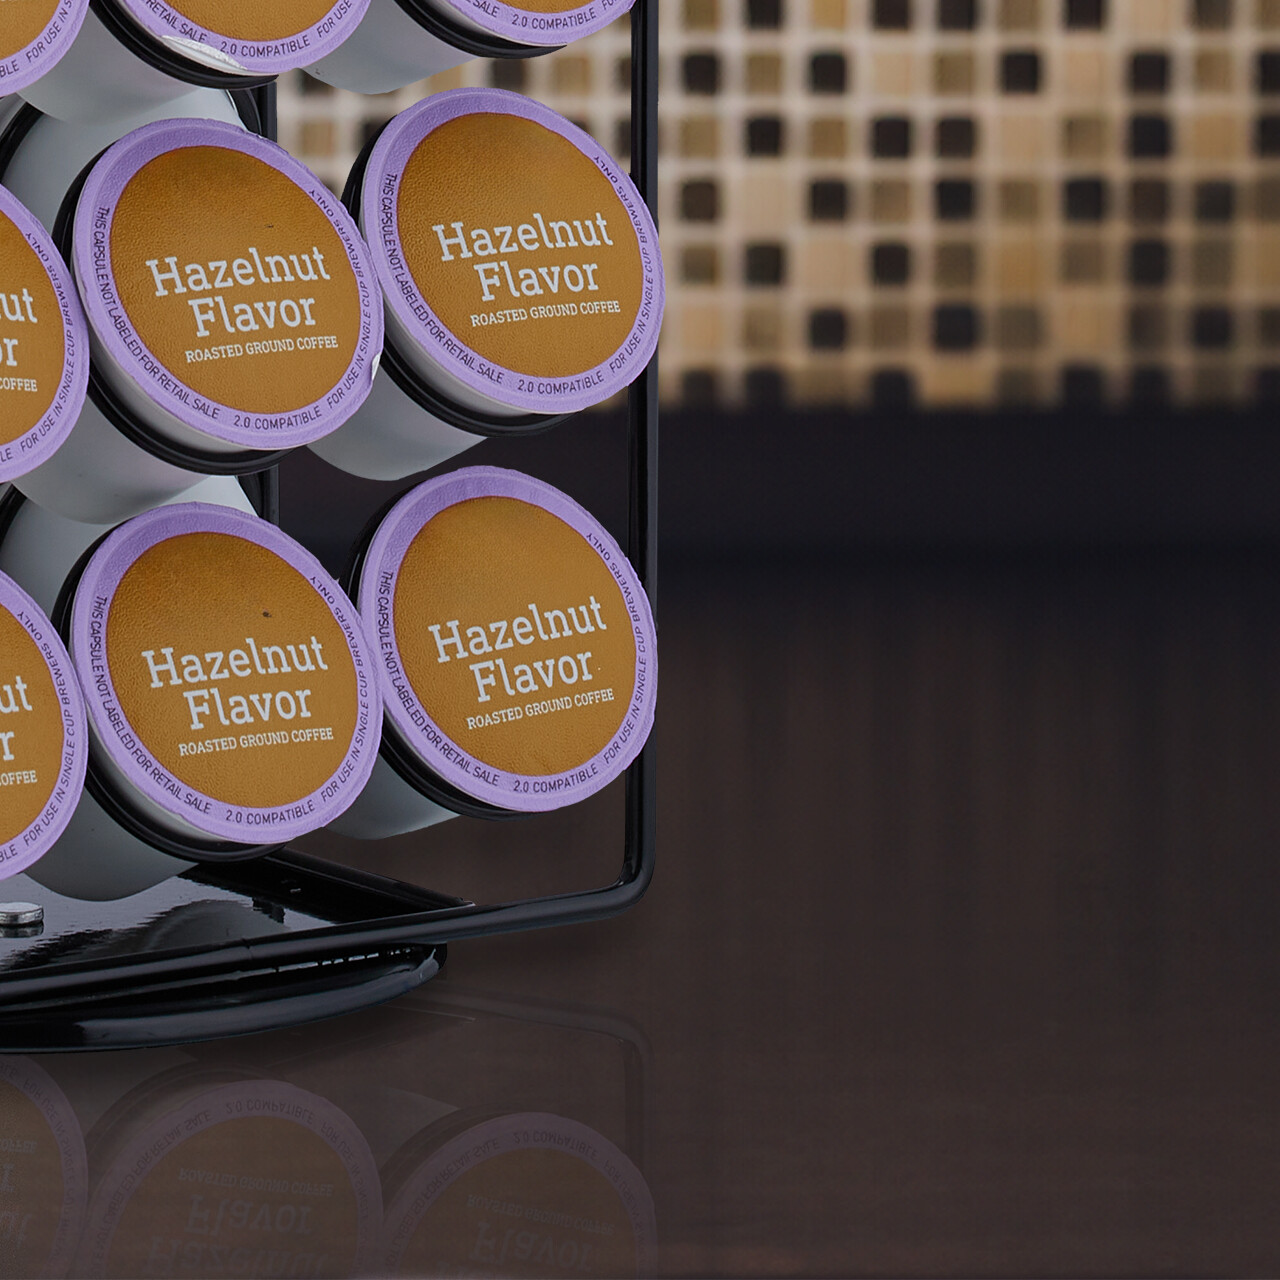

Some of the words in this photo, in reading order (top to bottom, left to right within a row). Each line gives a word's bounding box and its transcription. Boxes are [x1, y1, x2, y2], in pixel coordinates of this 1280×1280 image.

[512, 13, 529, 28] 2.0
[532, 6, 597, 29] COMPATIBLE
[220, 41, 238, 56] 2.0
[241, 35, 311, 58] COMPATIBLE
[432, 212, 614, 261] Hazelnut
[145, 246, 331, 296] Hazelnut
[473, 260, 599, 302] Flavor
[187, 295, 316, 337] Flavor
[469, 308, 528, 327] ROASTED
[529, 301, 578, 319] GROUND
[579, 300, 621, 314] COFFEE
[184, 343, 243, 363] ROASTED
[245, 337, 295, 355] GROUND
[296, 335, 339, 350] COFFEE
[518, 379, 535, 393] 2.0
[538, 369, 606, 394] COMPATIBLE
[235, 416, 252, 430] 2.0
[256, 406, 324, 431] COMPATIBLE
[310, 576, 336, 607] ONLY
[92, 596, 108, 619] THIS
[334, 607, 364, 669] BREWERS
[428, 598, 609, 662] Hazelnut
[90, 620, 103, 672] CAPSULE
[141, 636, 329, 688] Hazelnut
[95, 674, 111, 698] NOT
[360, 672, 368, 700] CUP
[469, 652, 593, 702] Flavor
[182, 687, 311, 730] Flavor
[466, 705, 523, 729] ROASTED
[524, 695, 572, 716] GROUND
[573, 689, 615, 707] COFFEE
[102, 699, 137, 751] LABELED
[356, 703, 370, 747] SINGLE
[178, 736, 237, 756] ROASTED
[239, 730, 289, 748] GROUND
[291, 728, 334, 743] COFFEE
[350, 747, 362, 763] IN
[131, 748, 153, 773] FOR
[337, 761, 354, 785] USE
[149, 767, 183, 801] RETAIL
[320, 780, 339, 802] FOR
[513, 780, 530, 793] 2.0
[533, 763, 599, 794] COMPATIBLE
[184, 792, 212, 815] SALE
[225, 809, 243, 823] 2.0
[246, 799, 315, 825] COMPATIBLE
